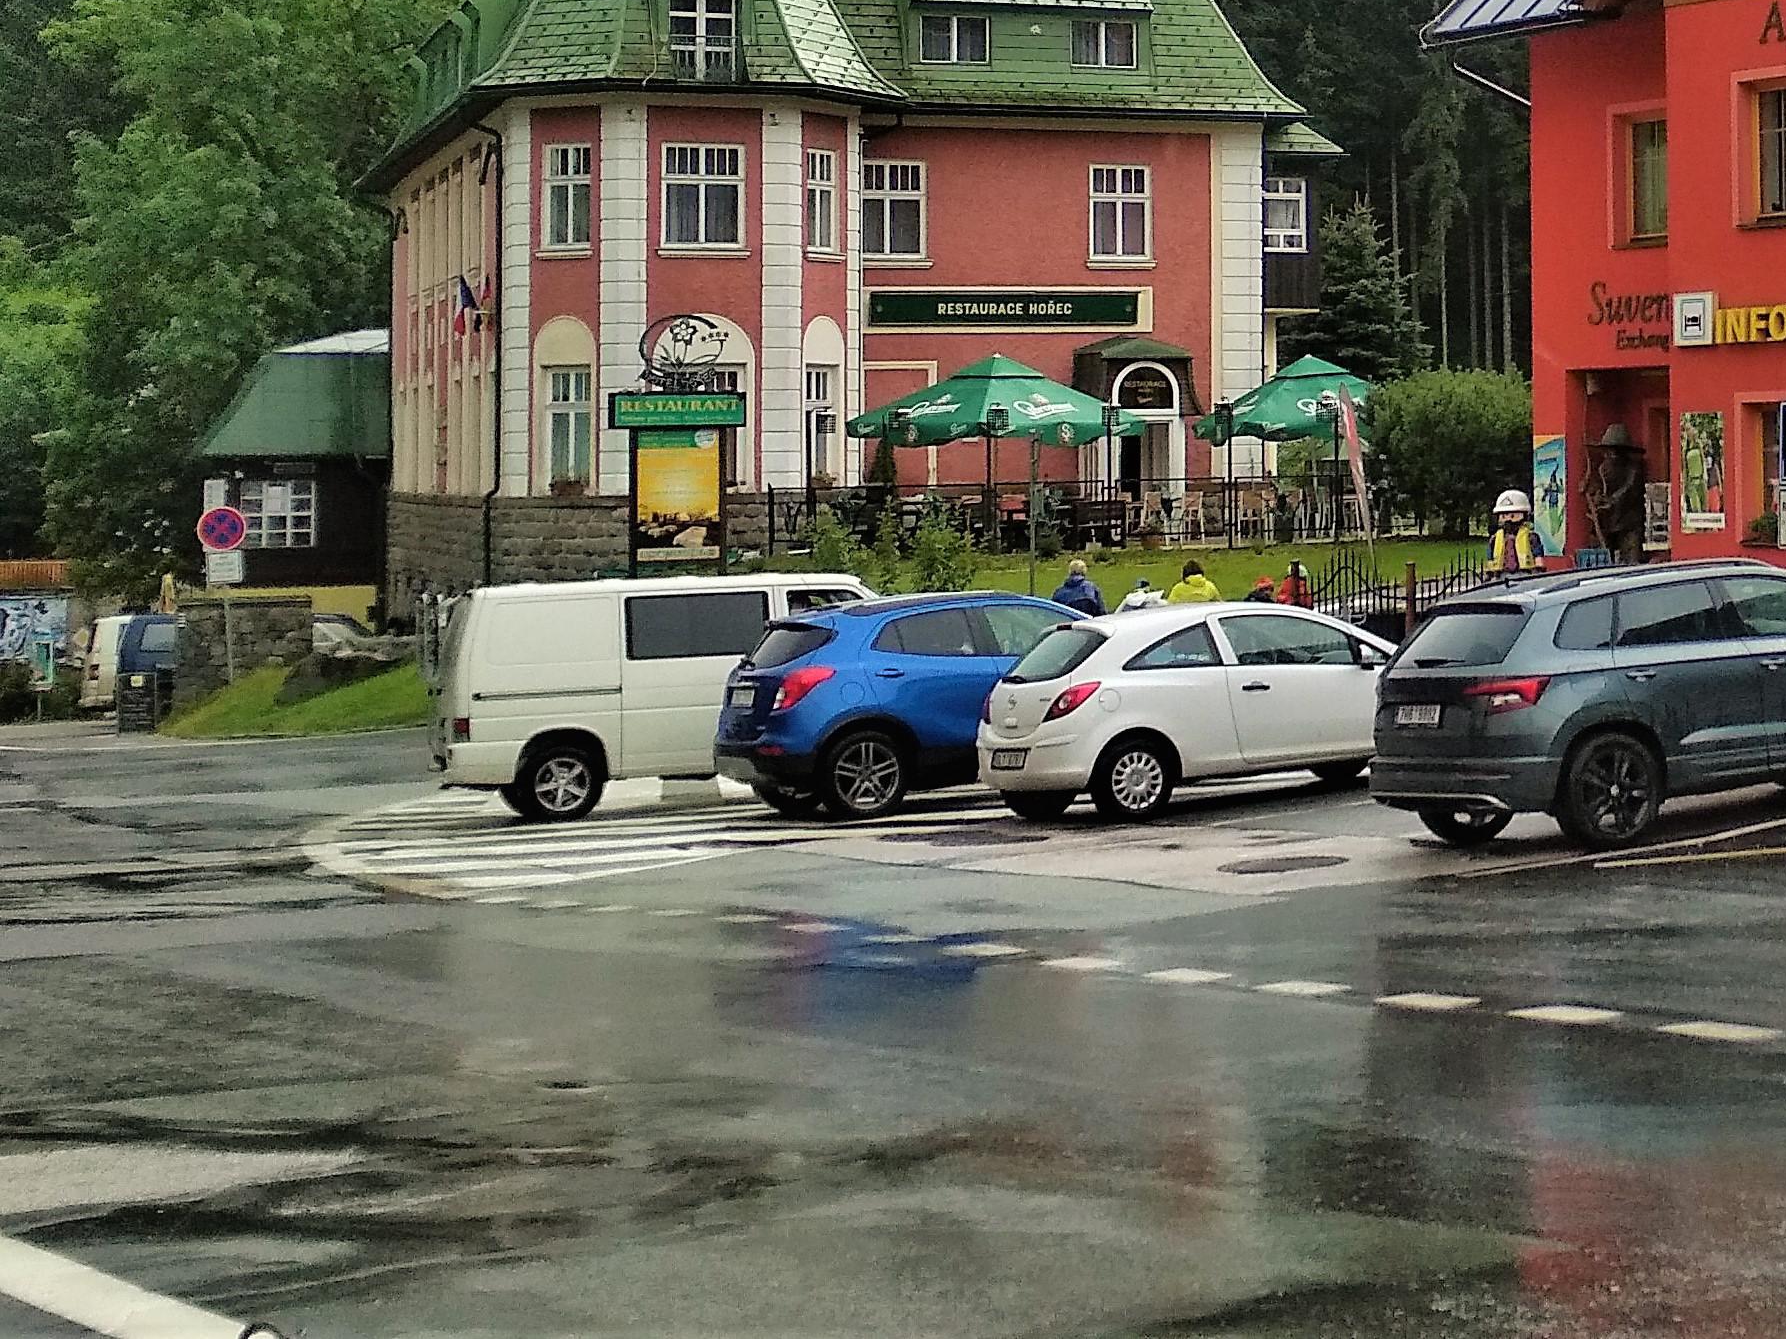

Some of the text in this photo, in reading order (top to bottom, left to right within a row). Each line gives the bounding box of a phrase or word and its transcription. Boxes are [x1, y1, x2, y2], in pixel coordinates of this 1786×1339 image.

[937, 299, 1073, 316] RESTAURACE HOŘEC
[621, 399, 738, 412] RESTAURANT
